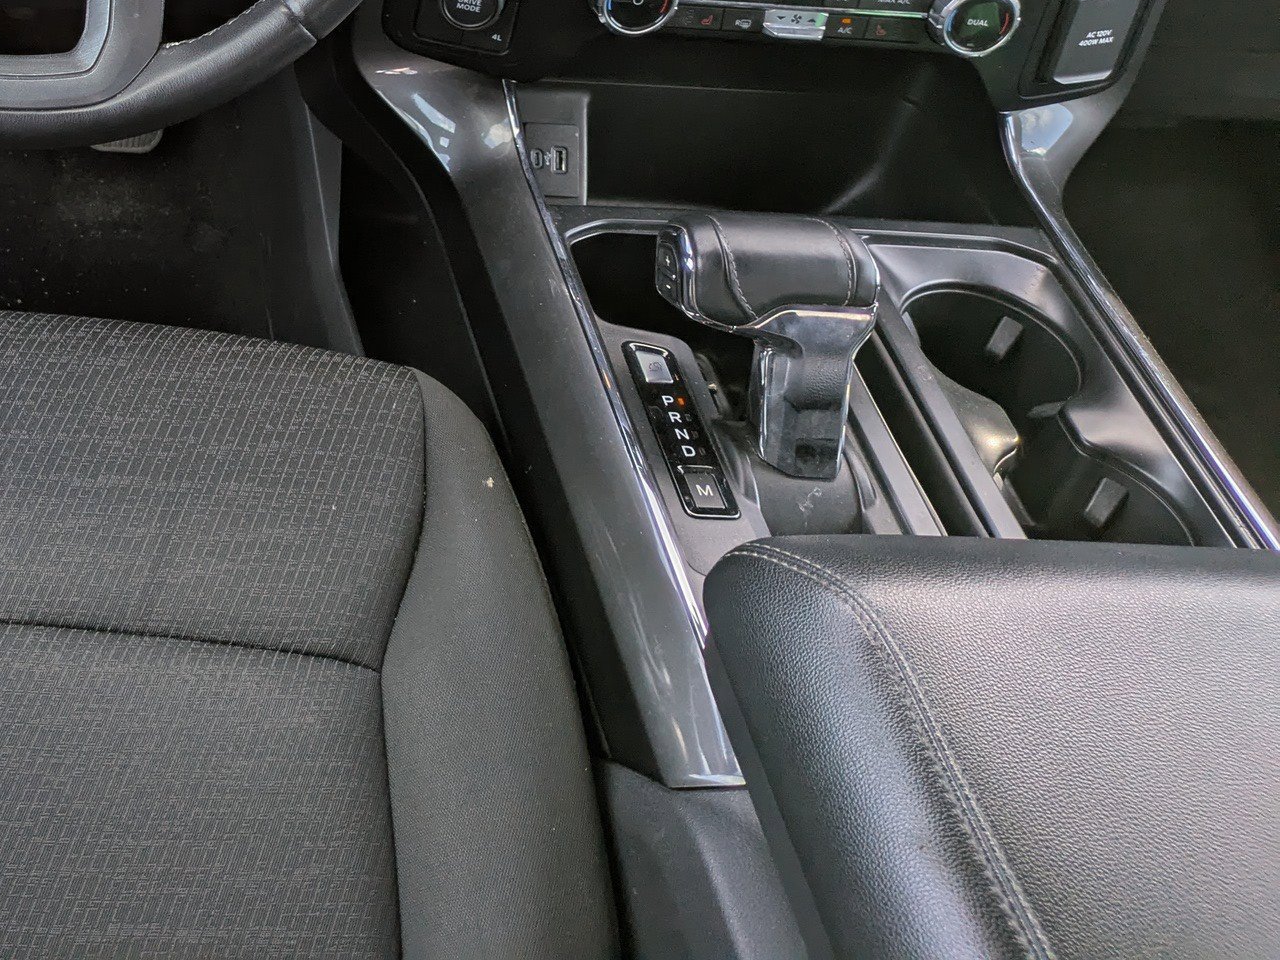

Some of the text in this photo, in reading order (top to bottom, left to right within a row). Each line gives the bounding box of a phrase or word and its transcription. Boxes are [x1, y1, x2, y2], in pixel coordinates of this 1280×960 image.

[456, 3, 481, 13] MODE
[967, 19, 988, 27] DUAL
[838, 27, 852, 35] A/C
[1097, 30, 1113, 38] 120V
[662, 395, 674, 406] P
[668, 412, 682, 423] R
[675, 429, 690, 440] N
[682, 446, 696, 457] D
[696, 485, 714, 496] M
